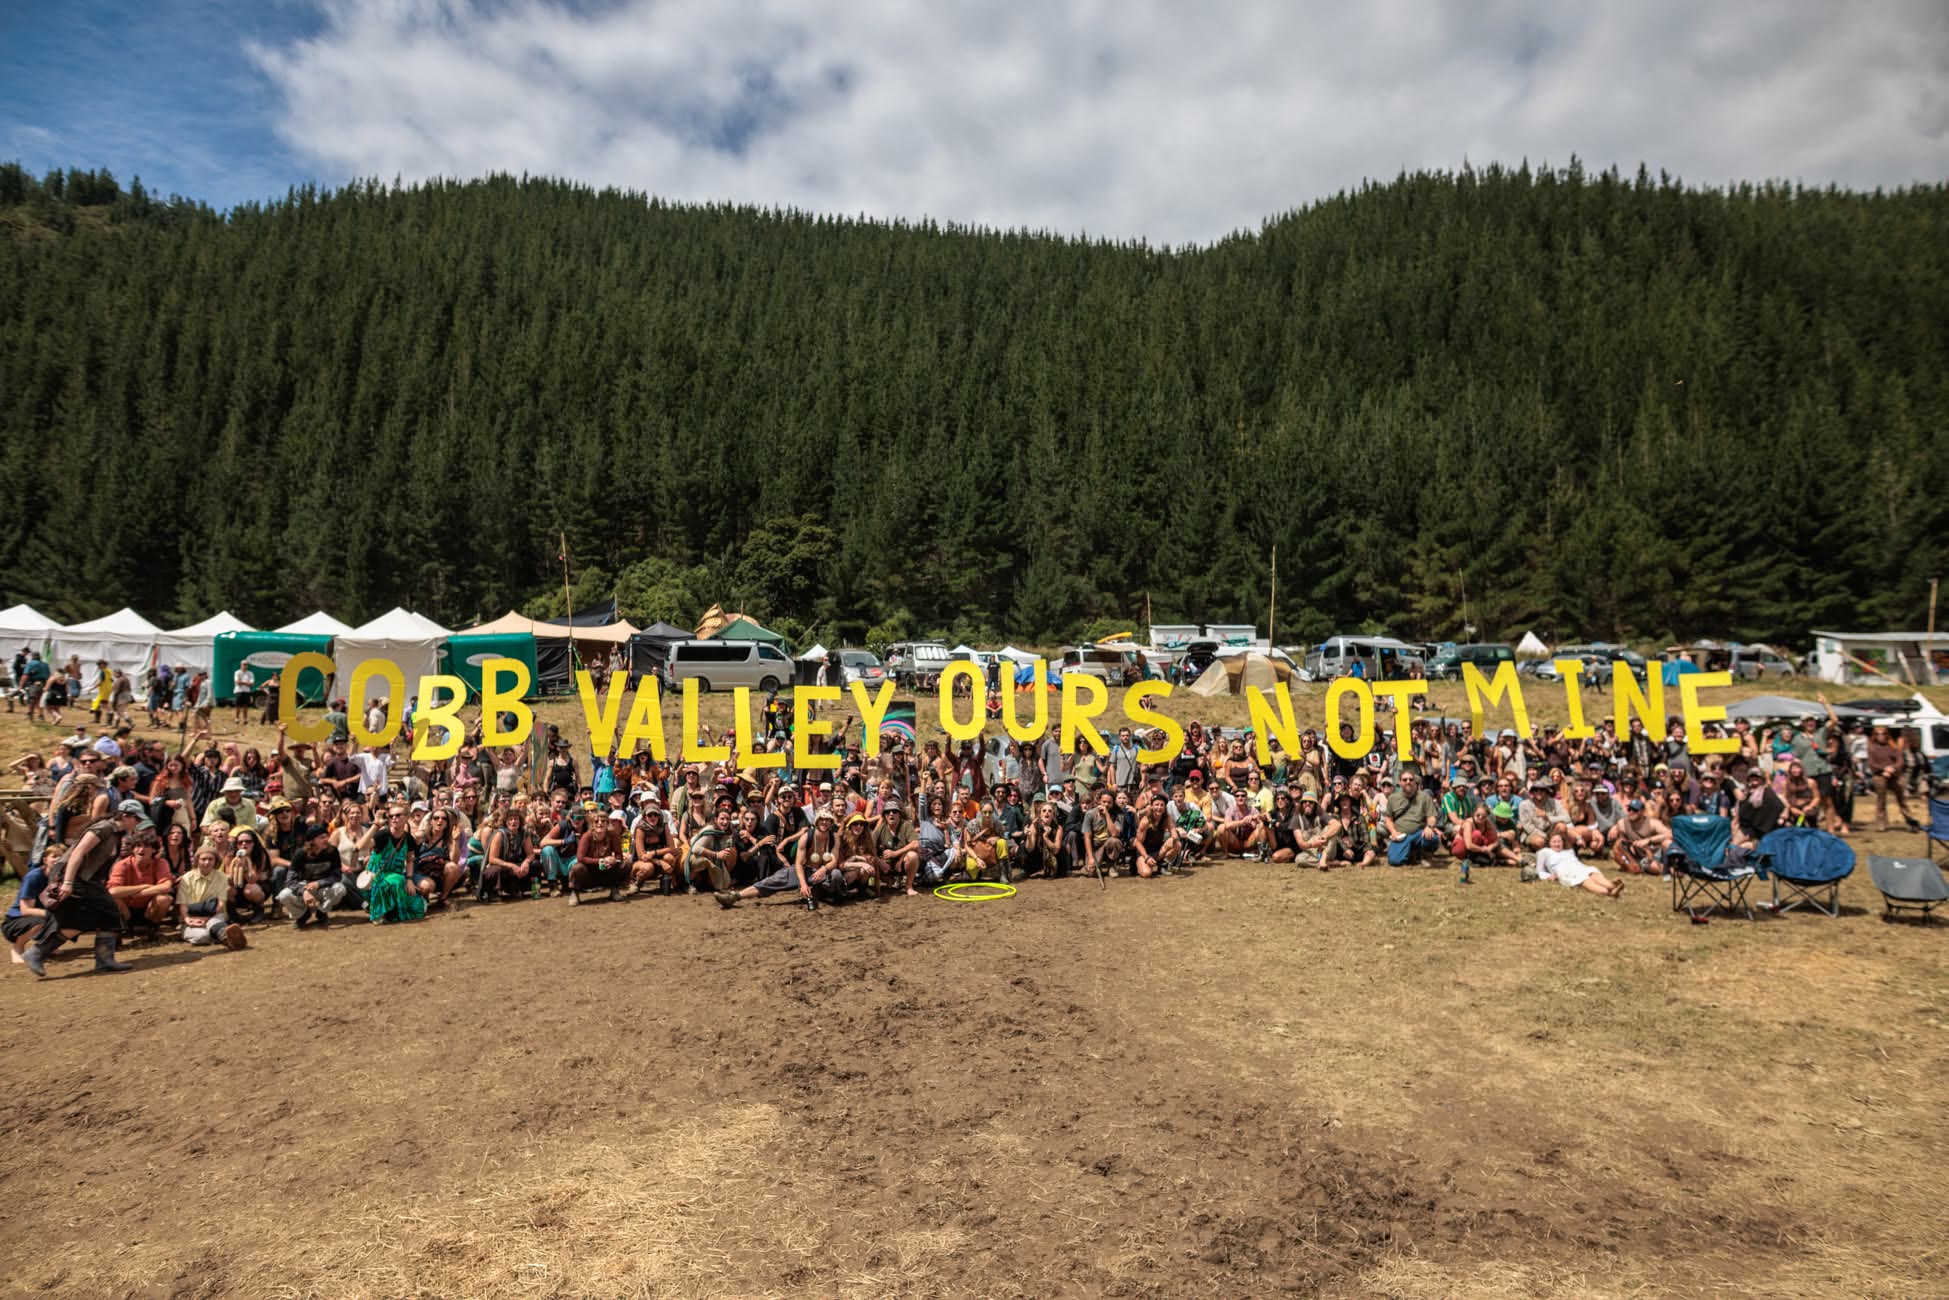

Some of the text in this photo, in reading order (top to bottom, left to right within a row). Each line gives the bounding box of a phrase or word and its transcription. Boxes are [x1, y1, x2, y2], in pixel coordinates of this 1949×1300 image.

[278, 652, 1742, 769] COBB VALLEY OURS NOT MINE
